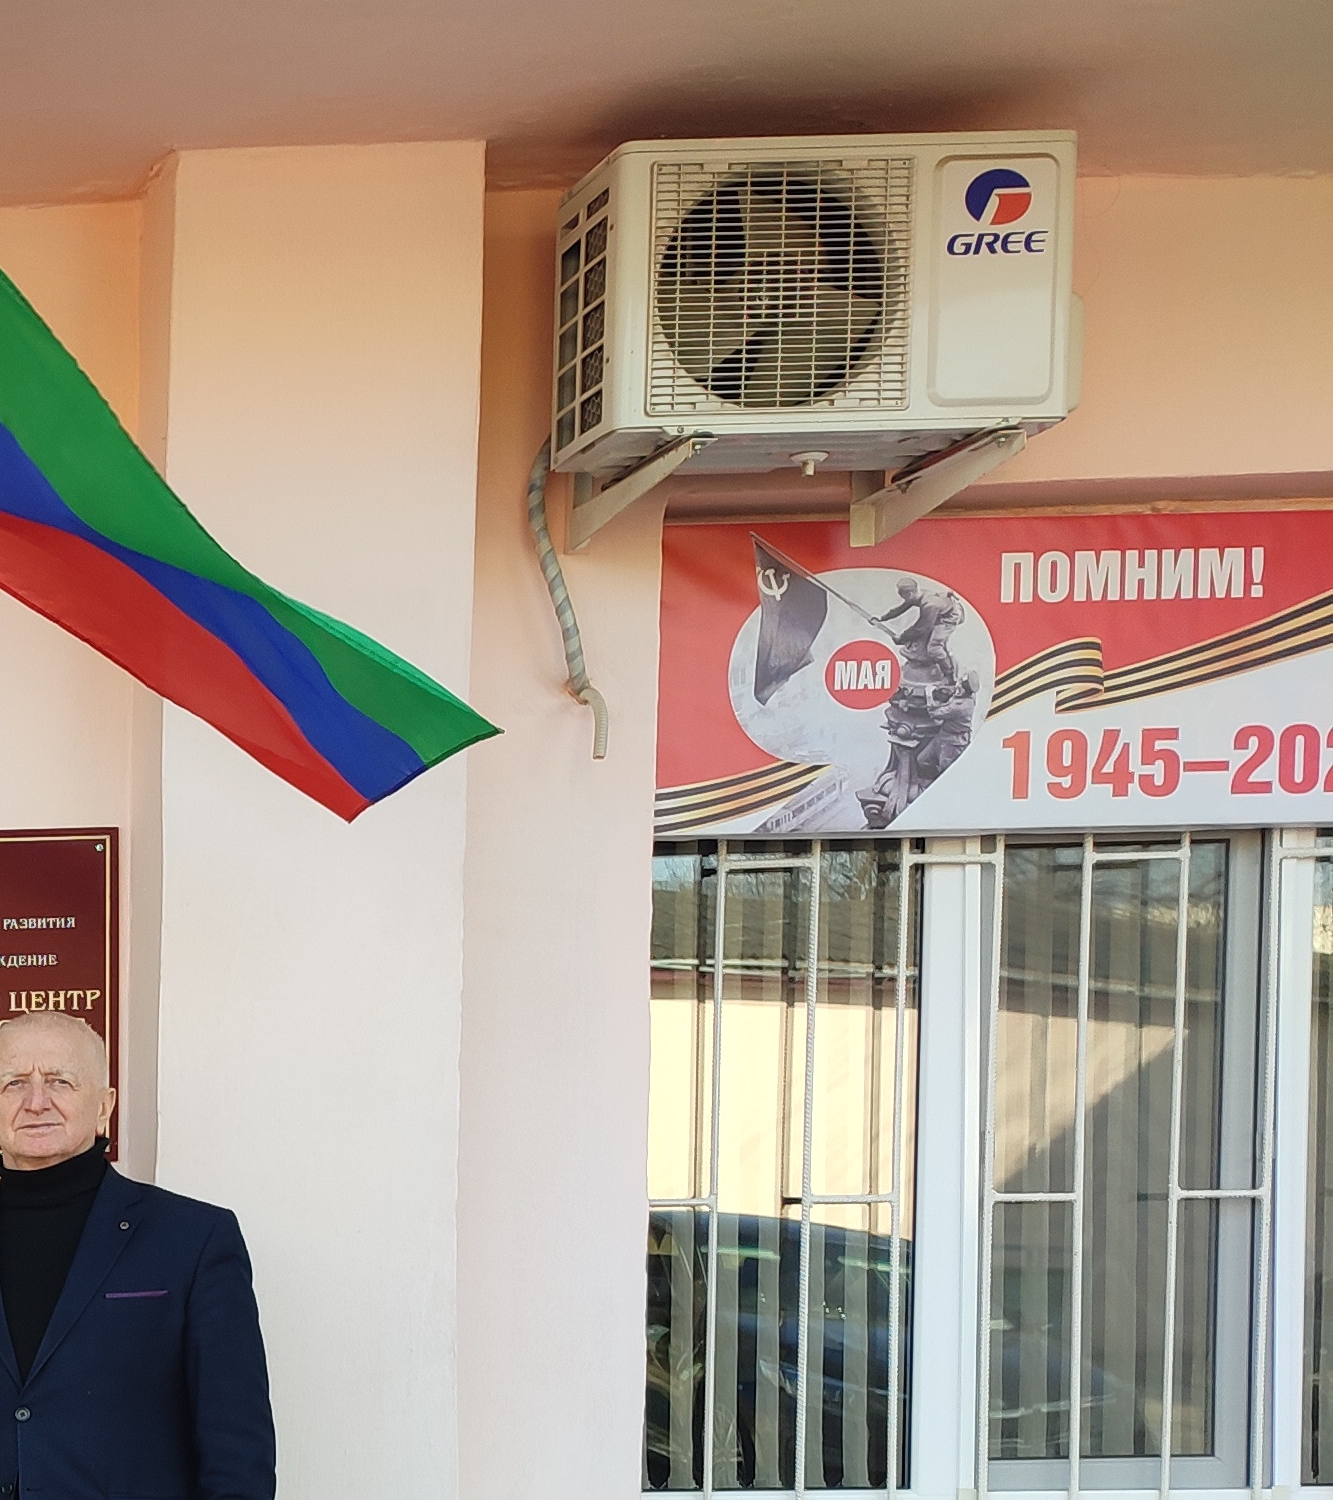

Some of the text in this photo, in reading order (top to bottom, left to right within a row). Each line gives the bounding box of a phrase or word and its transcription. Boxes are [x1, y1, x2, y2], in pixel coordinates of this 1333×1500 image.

[947, 230, 1049, 256] GREE
[1000, 547, 1265, 603] ПОМНИМ!
[834, 660, 891, 690] МАЯ
[1002, 723, 1333, 800] 1945–20
[3, 917, 76, 930] РАЗВИТИЯ
[8, 989, 101, 1014] ЦЕНТР
